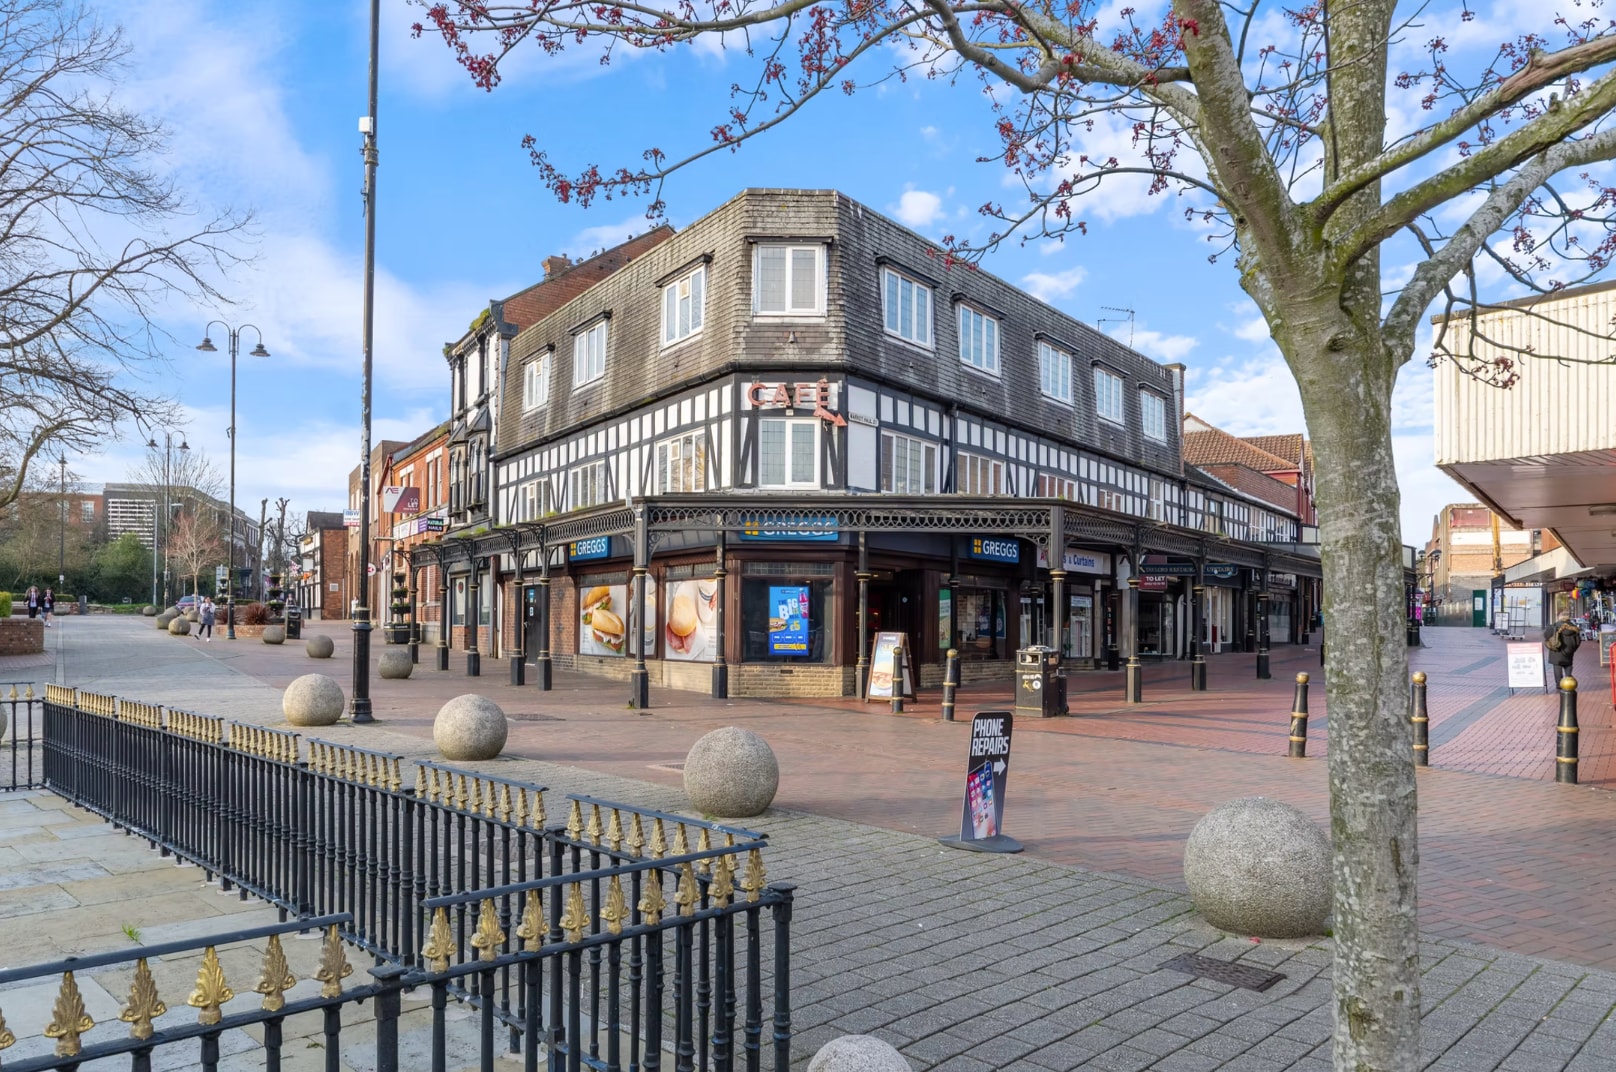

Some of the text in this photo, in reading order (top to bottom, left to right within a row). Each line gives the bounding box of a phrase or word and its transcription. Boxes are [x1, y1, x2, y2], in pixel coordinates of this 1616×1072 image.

[577, 538, 606, 556] GREGGS
[982, 540, 1018, 558] GREGGS
[1073, 554, 1095, 567] Curtains
[778, 598, 798, 620] BIG
[973, 718, 1004, 737] PHONE
[971, 736, 1010, 756] REPAIRS
